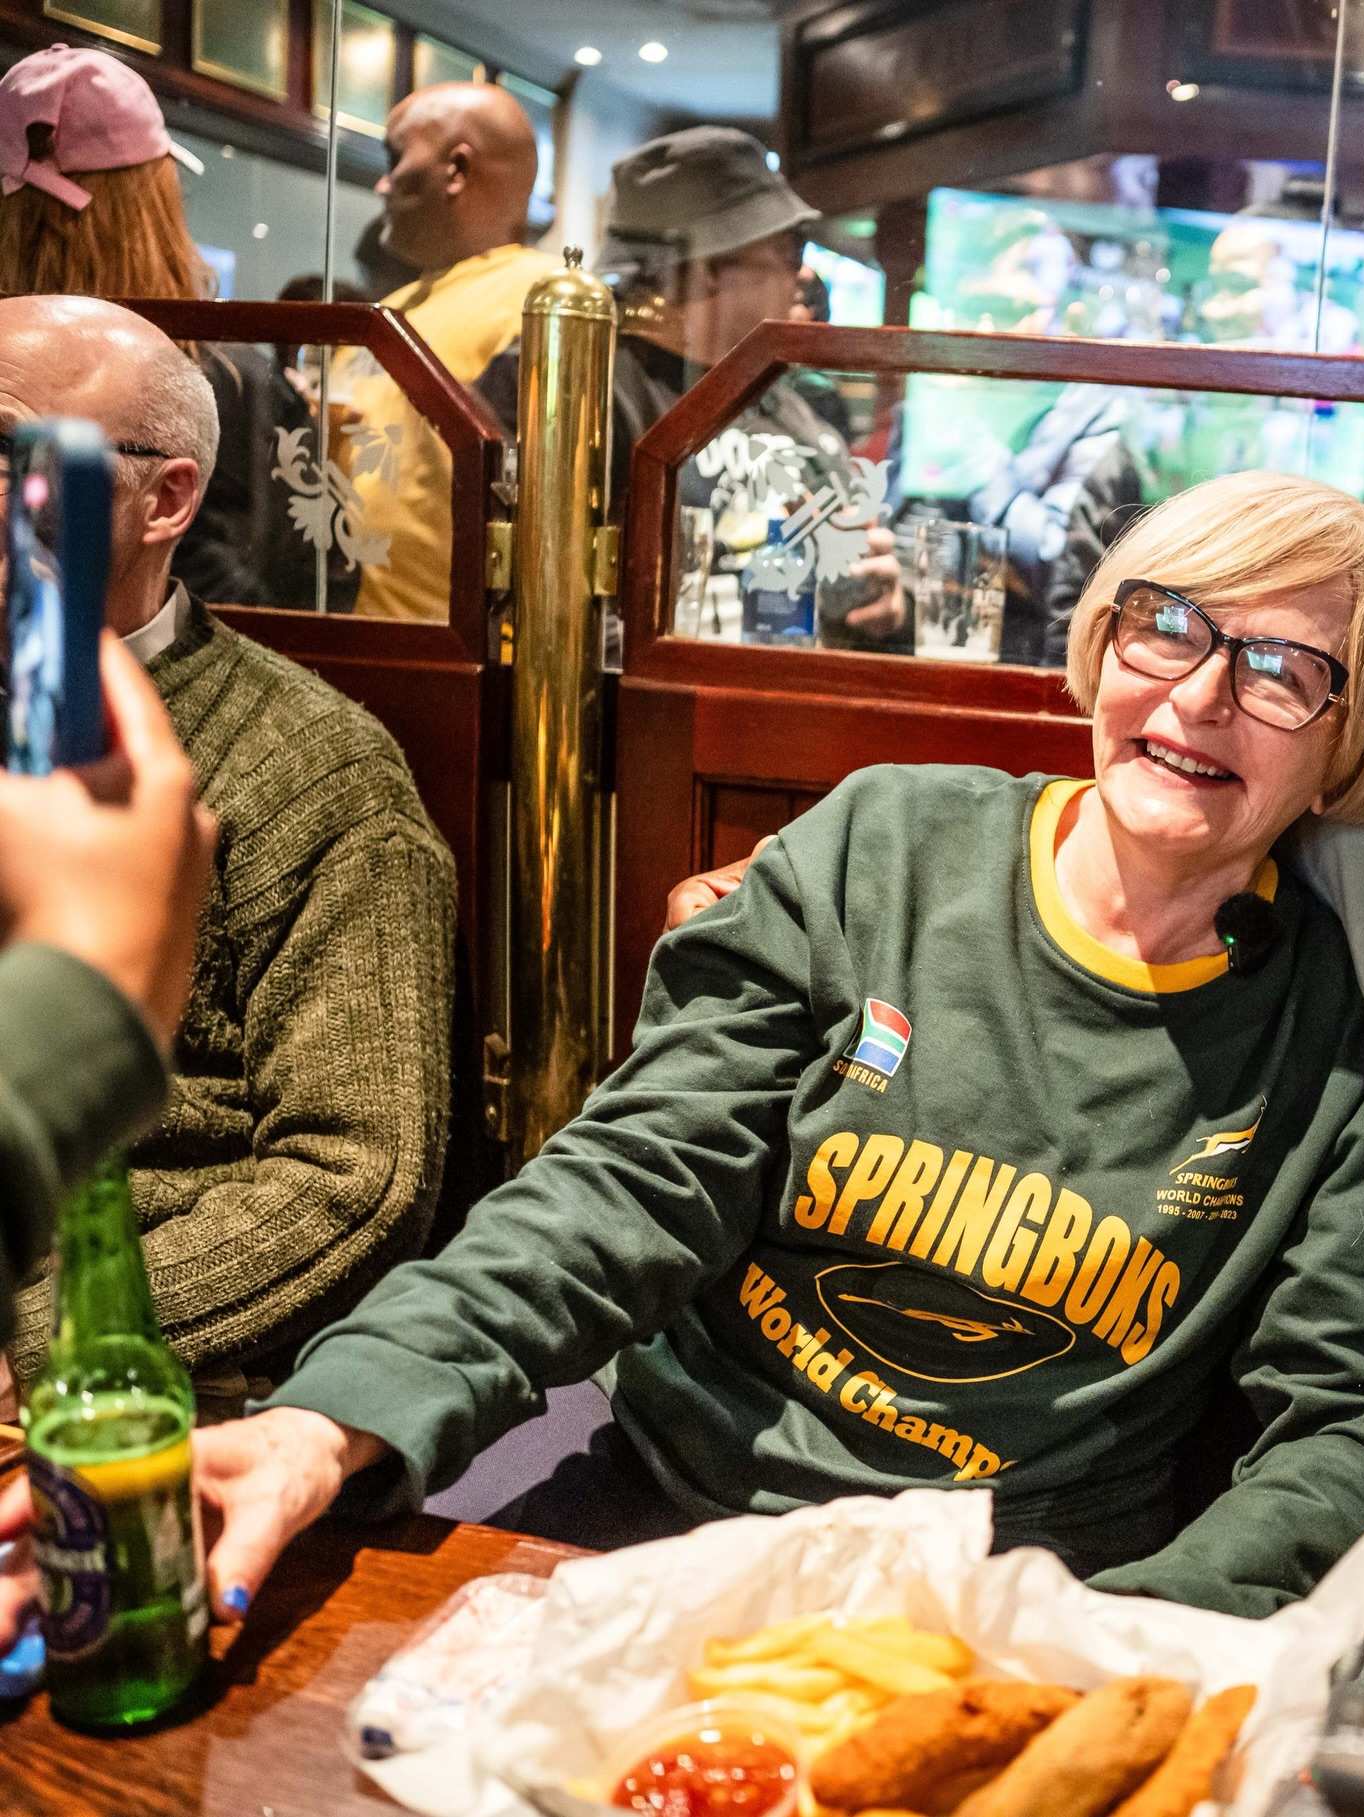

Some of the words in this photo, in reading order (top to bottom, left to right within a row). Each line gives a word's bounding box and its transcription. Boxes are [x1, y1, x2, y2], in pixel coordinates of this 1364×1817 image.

[1174, 1172, 1239, 1191] SPRING
[1156, 1189, 1201, 1206] WORLD
[1157, 1204, 1181, 1217] 1995
[1186, 1209, 1205, 1220] 2007
[794, 1131, 1181, 1366] SPRINGBOKS
[739, 1261, 855, 1394] World
